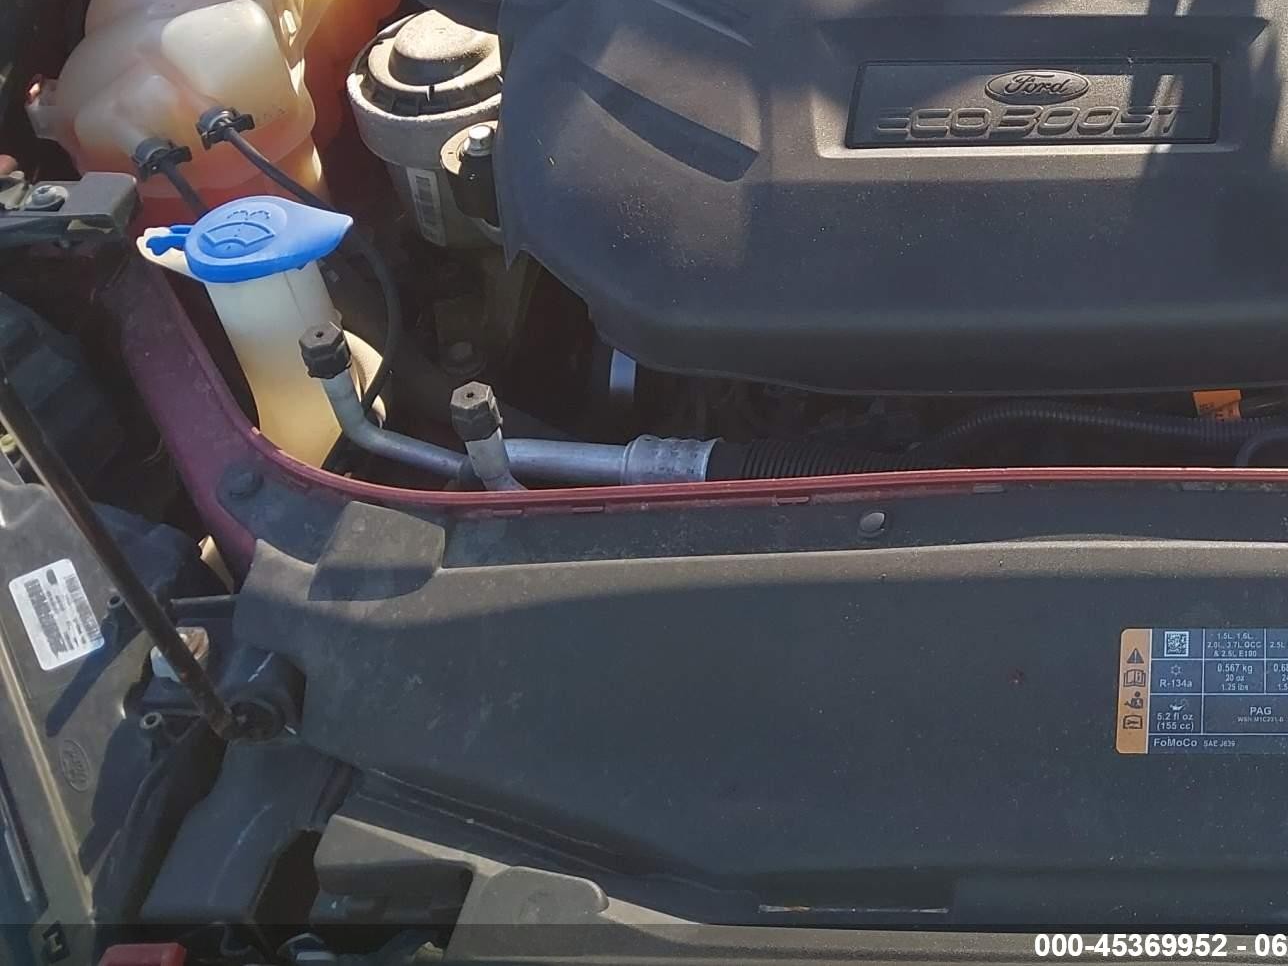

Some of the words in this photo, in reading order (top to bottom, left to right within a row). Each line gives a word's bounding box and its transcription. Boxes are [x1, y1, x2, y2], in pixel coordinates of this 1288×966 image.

[1242, 663, 1253, 675] kg
[1225, 674, 1234, 682] 20
[1159, 678, 1193, 688] R-134a
[1249, 706, 1272, 715] PAG
[1156, 712, 1171, 721] 5.2
[1173, 712, 1180, 721] fl
[1182, 713, 1194, 721] oz
[1156, 722, 1177, 731] (155
[1179, 722, 1194, 731] cc)
[1153, 737, 1198, 747] FoMoCo
